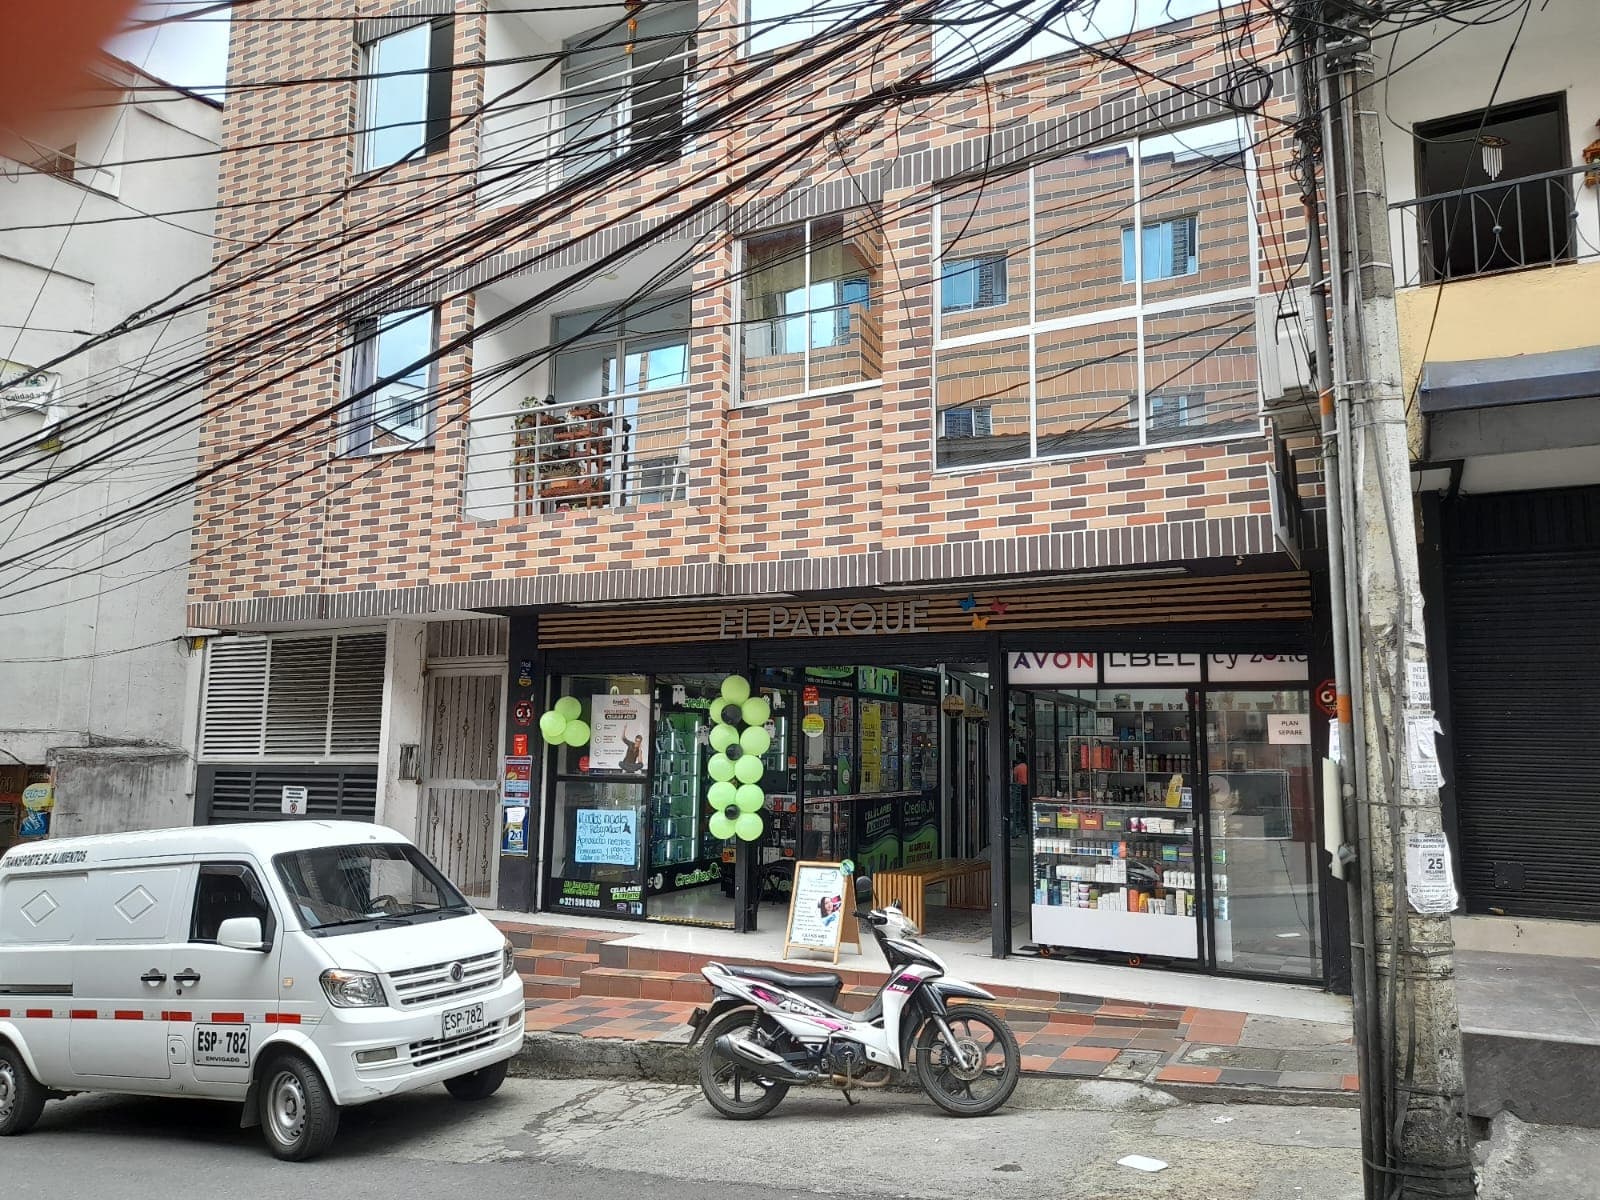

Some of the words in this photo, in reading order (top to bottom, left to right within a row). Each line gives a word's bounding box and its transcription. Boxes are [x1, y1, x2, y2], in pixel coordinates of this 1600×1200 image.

[719, 608, 759, 640] EL
[768, 599, 930, 638] PARQUE
[1013, 652, 1094, 669] AVON
[42, 853, 52, 865] DE
[51, 850, 88, 866] ALIMENTOS
[1427, 858, 1443, 870] 25
[205, 1055, 241, 1063] ENVIGADO
